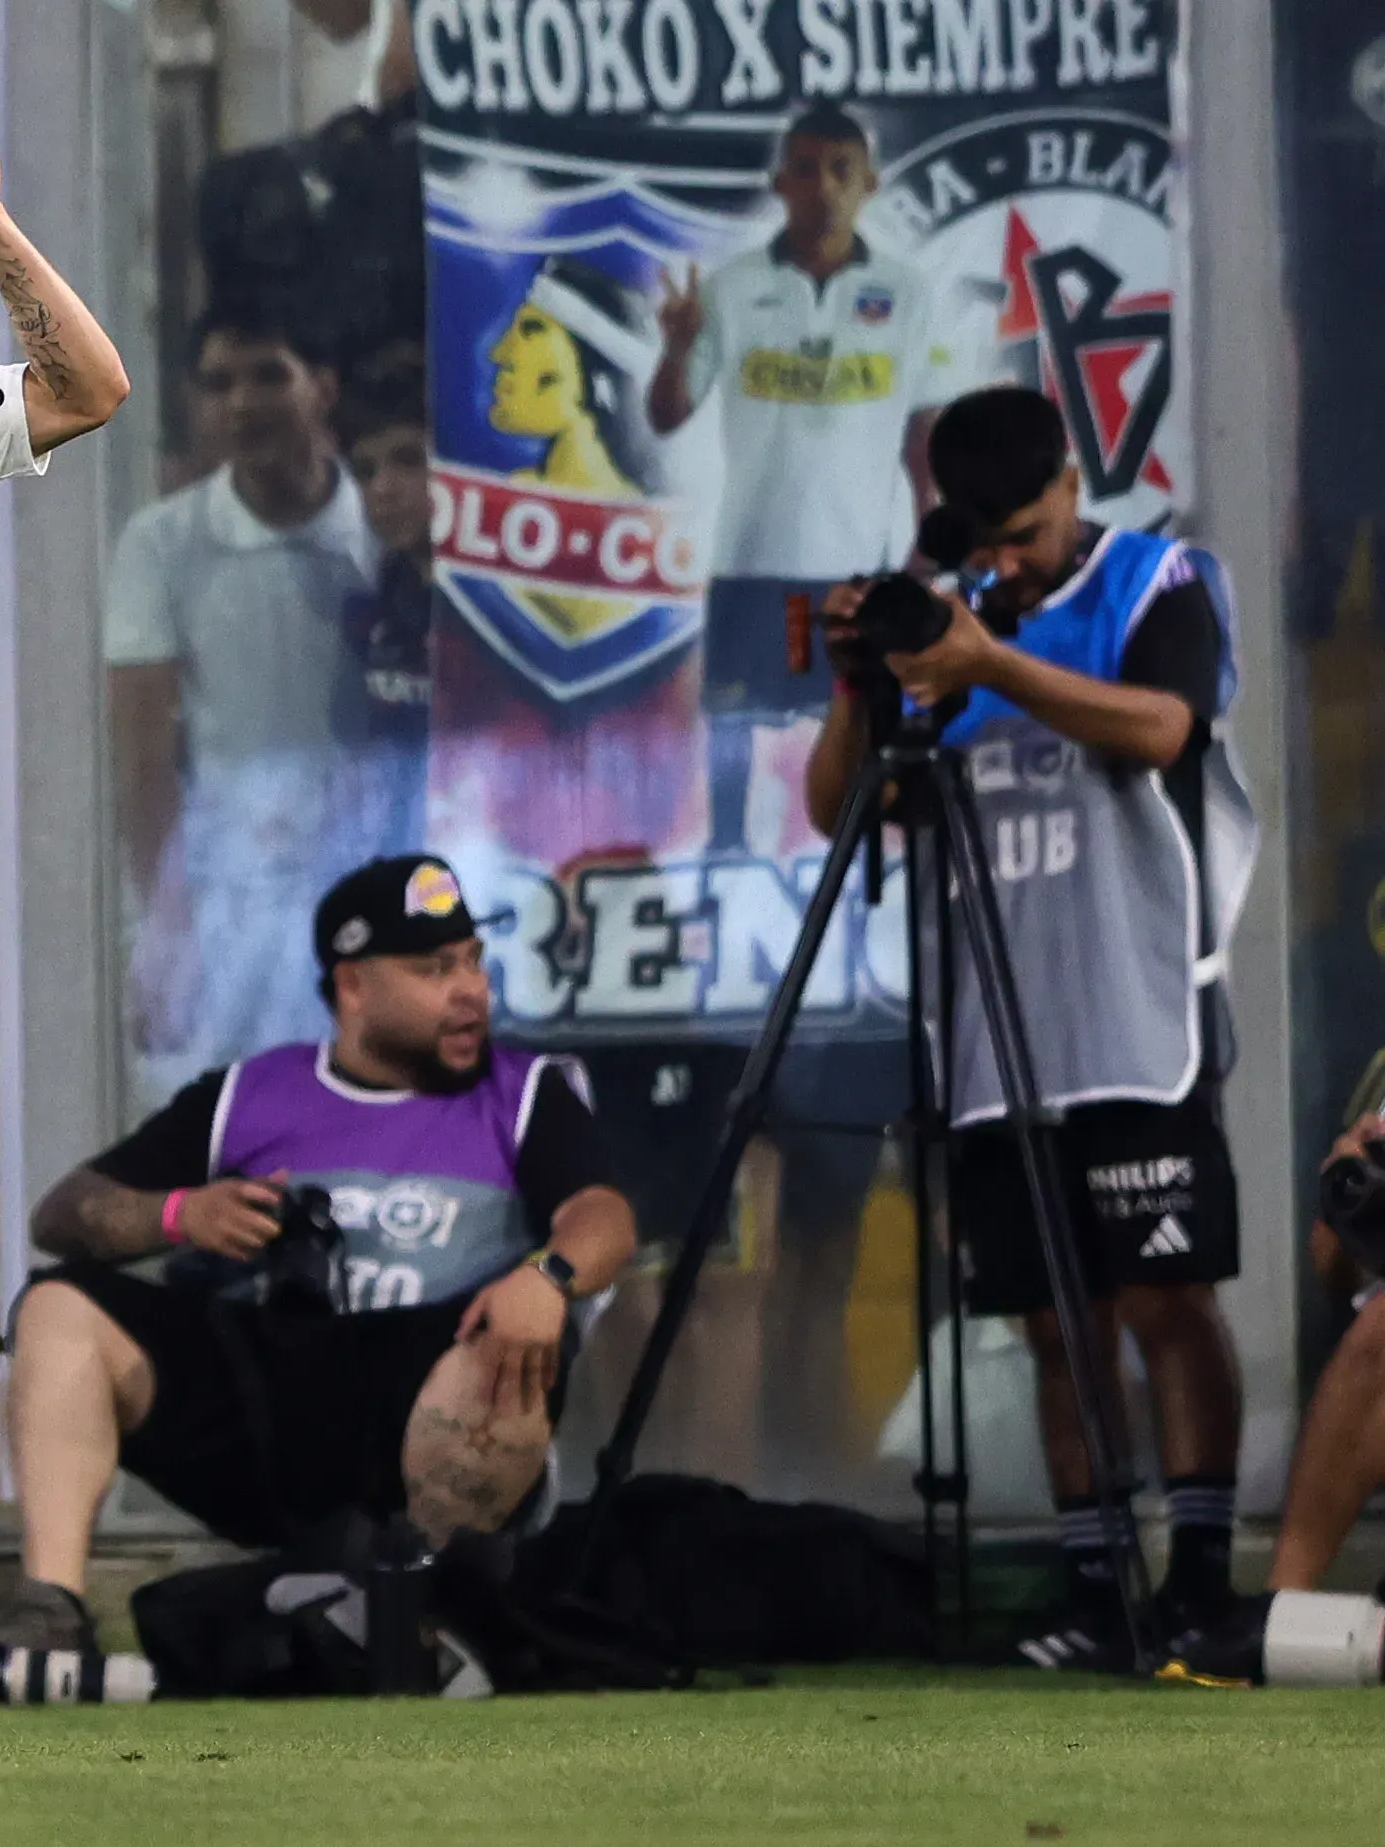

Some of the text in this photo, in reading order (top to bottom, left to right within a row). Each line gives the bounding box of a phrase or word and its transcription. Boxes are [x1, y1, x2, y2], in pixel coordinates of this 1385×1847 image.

[415, 0, 1159, 115] CHOKO X SIEMPRE
